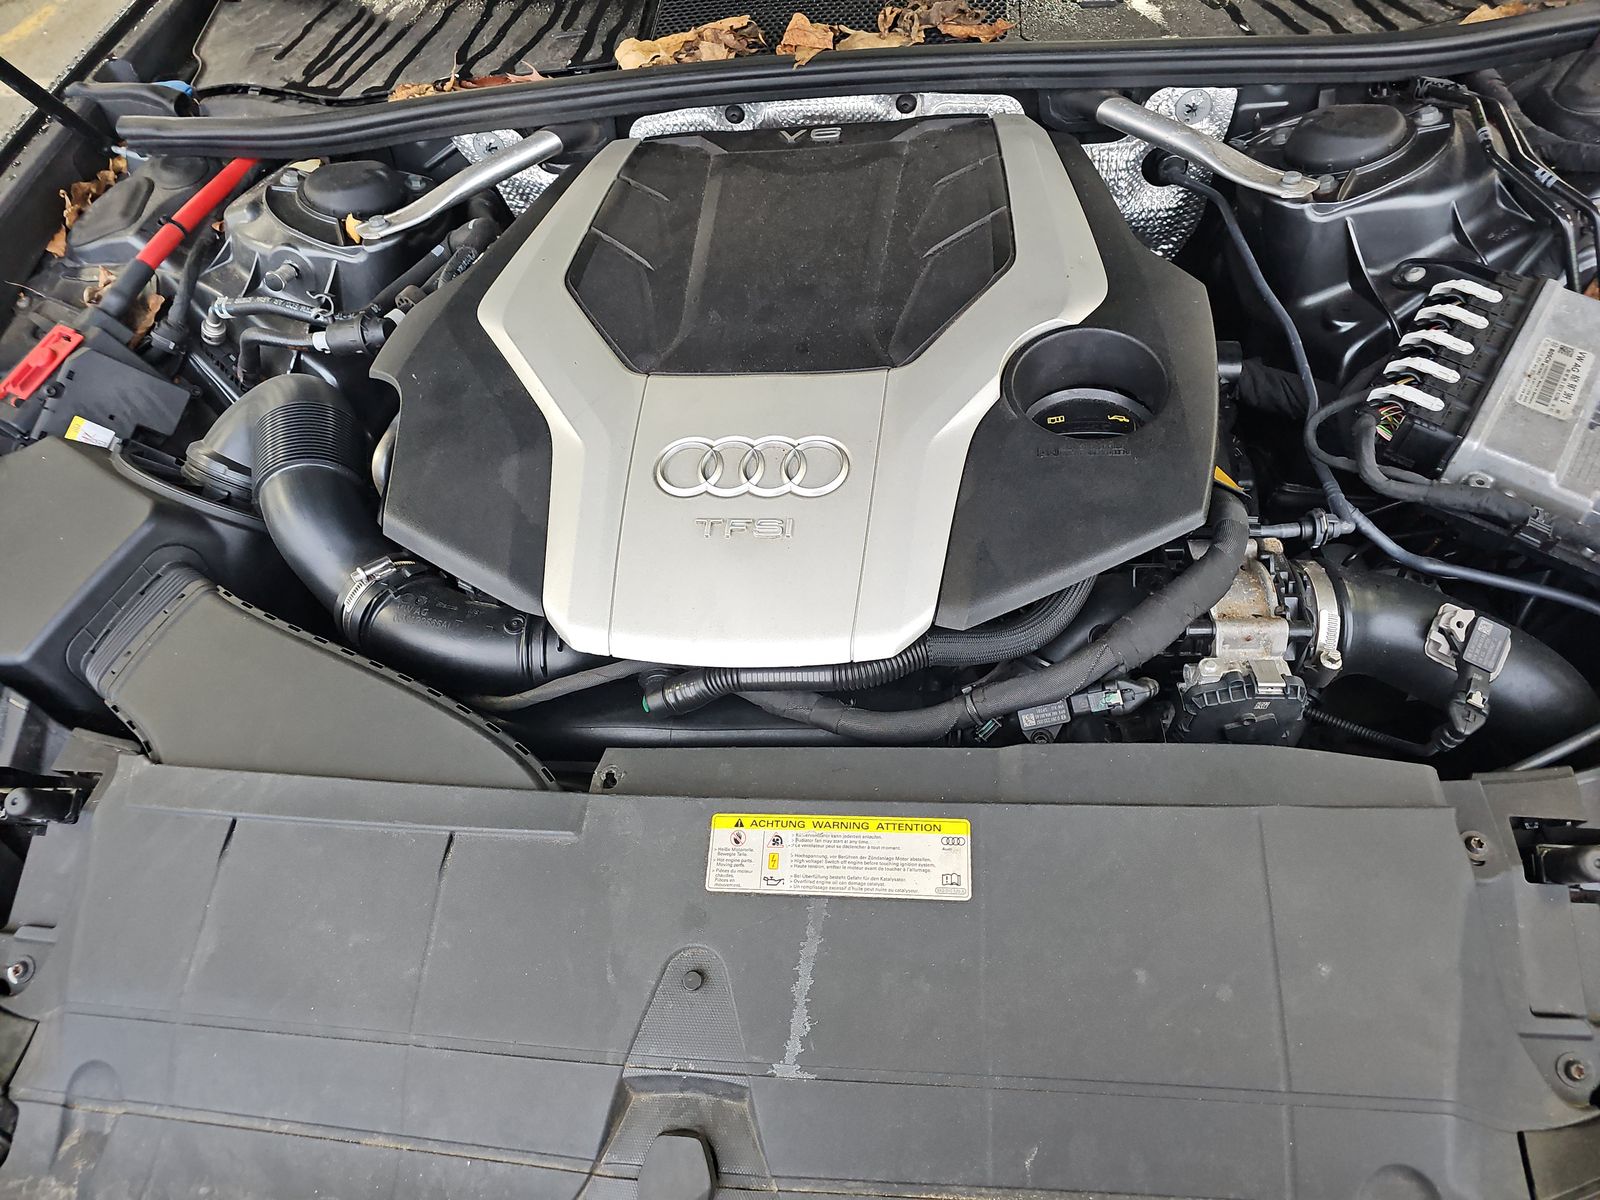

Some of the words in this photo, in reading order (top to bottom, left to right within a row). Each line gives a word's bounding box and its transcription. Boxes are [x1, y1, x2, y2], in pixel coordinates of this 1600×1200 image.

[780, 127, 841, 143] V6
[1544, 348, 1555, 364] BOSCH
[1576, 351, 1588, 364] VW
[1571, 362, 1582, 373] AG
[695, 518, 795, 539] TFSI
[750, 820, 806, 828] ACHTUNG
[812, 821, 870, 830] WARNING
[876, 822, 942, 832] ATTENTION
